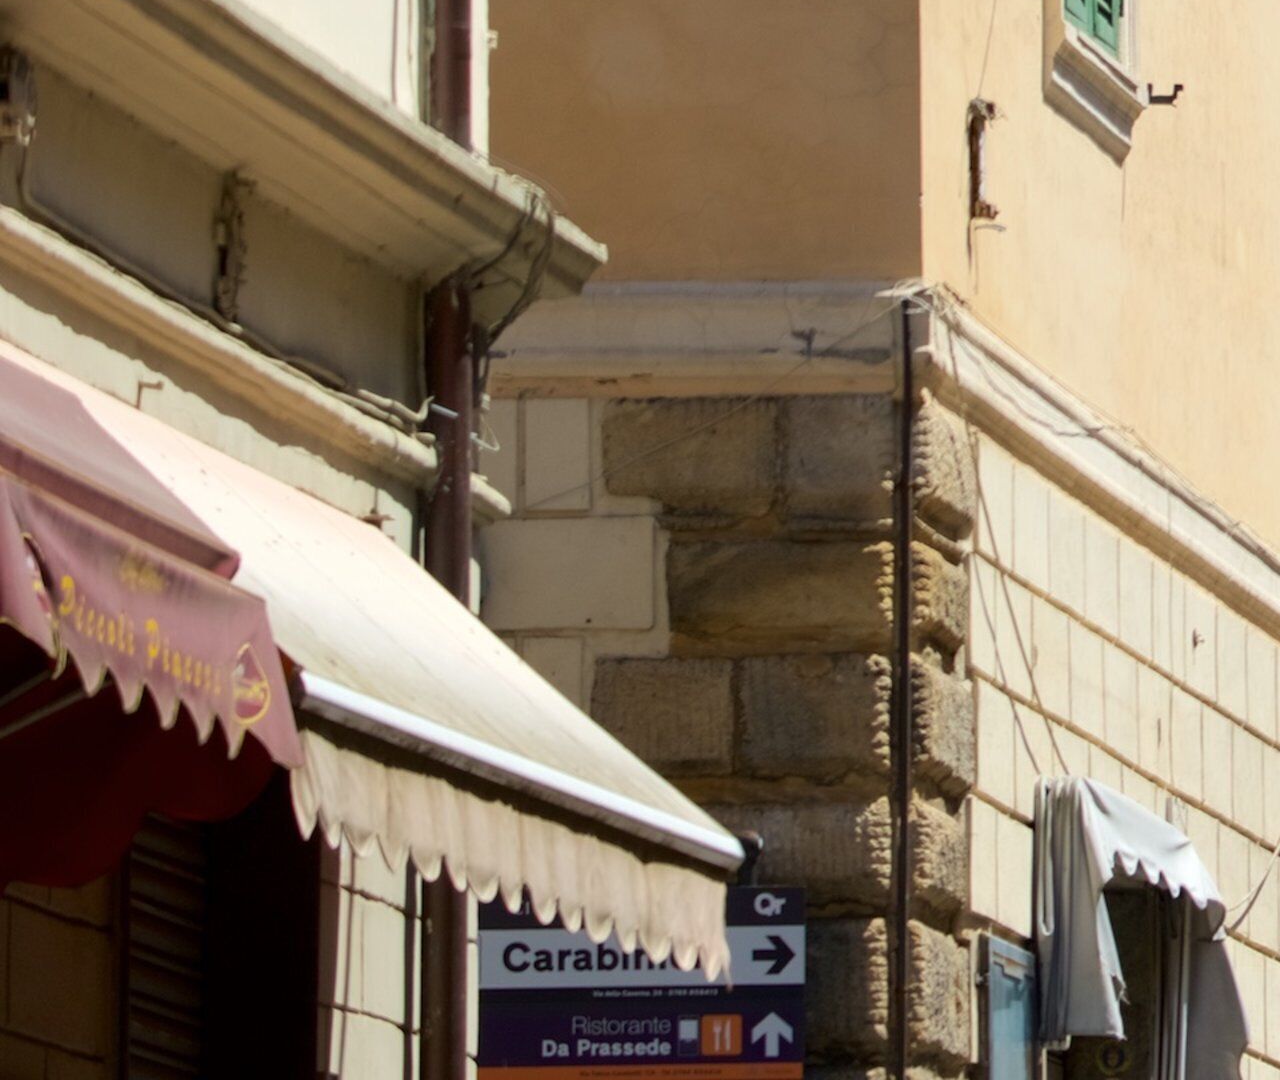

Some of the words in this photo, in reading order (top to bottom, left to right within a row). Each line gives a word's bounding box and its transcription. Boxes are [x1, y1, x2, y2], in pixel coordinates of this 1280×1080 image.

[571, 1016, 672, 1036] Ristorante
[541, 1039, 569, 1058] Da
[577, 1038, 672, 1057] Prassede
